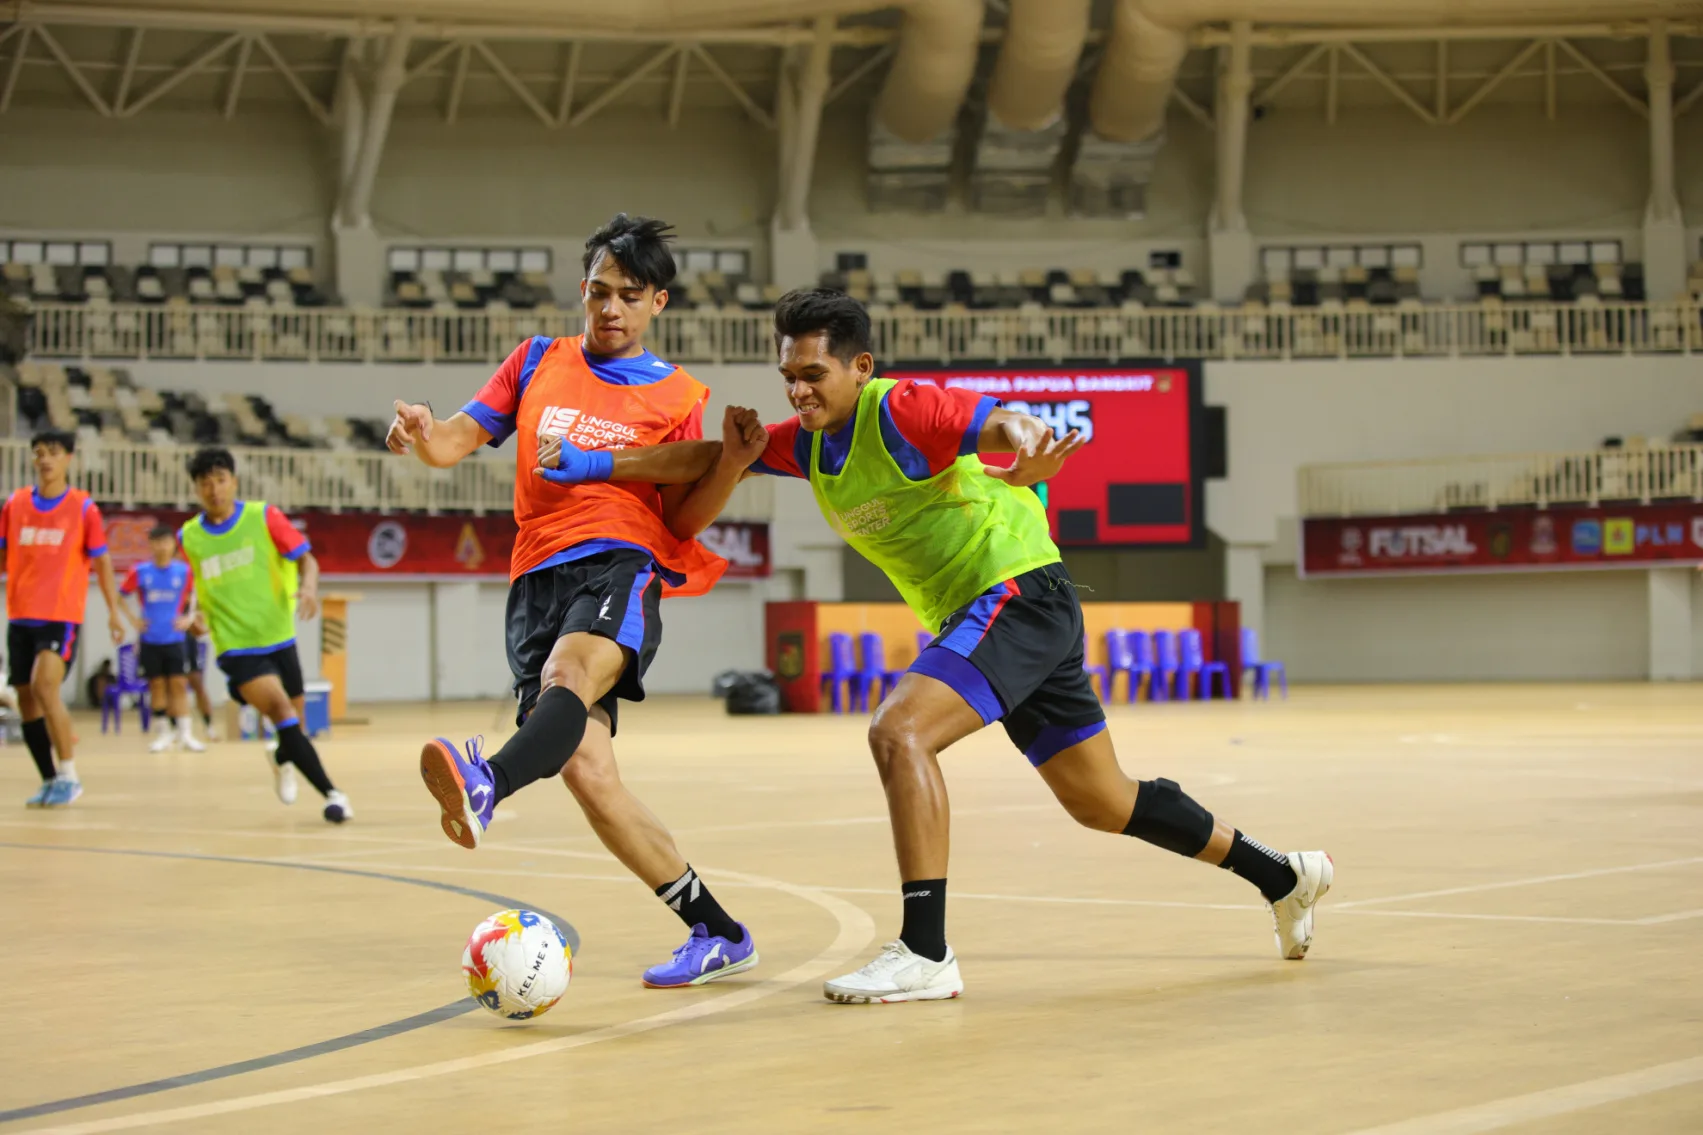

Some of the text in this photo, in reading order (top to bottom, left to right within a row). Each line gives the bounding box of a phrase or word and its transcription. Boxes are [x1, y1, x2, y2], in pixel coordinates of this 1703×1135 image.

[580, 414, 638, 439] UNGGUL
[839, 498, 884, 522] UNGGUL
[846, 505, 886, 530] SPORTS
[854, 516, 891, 536] ENTER
[1635, 523, 1684, 546] PLN
[1369, 525, 1476, 557] FUTSAL
[517, 951, 546, 997] KELME
